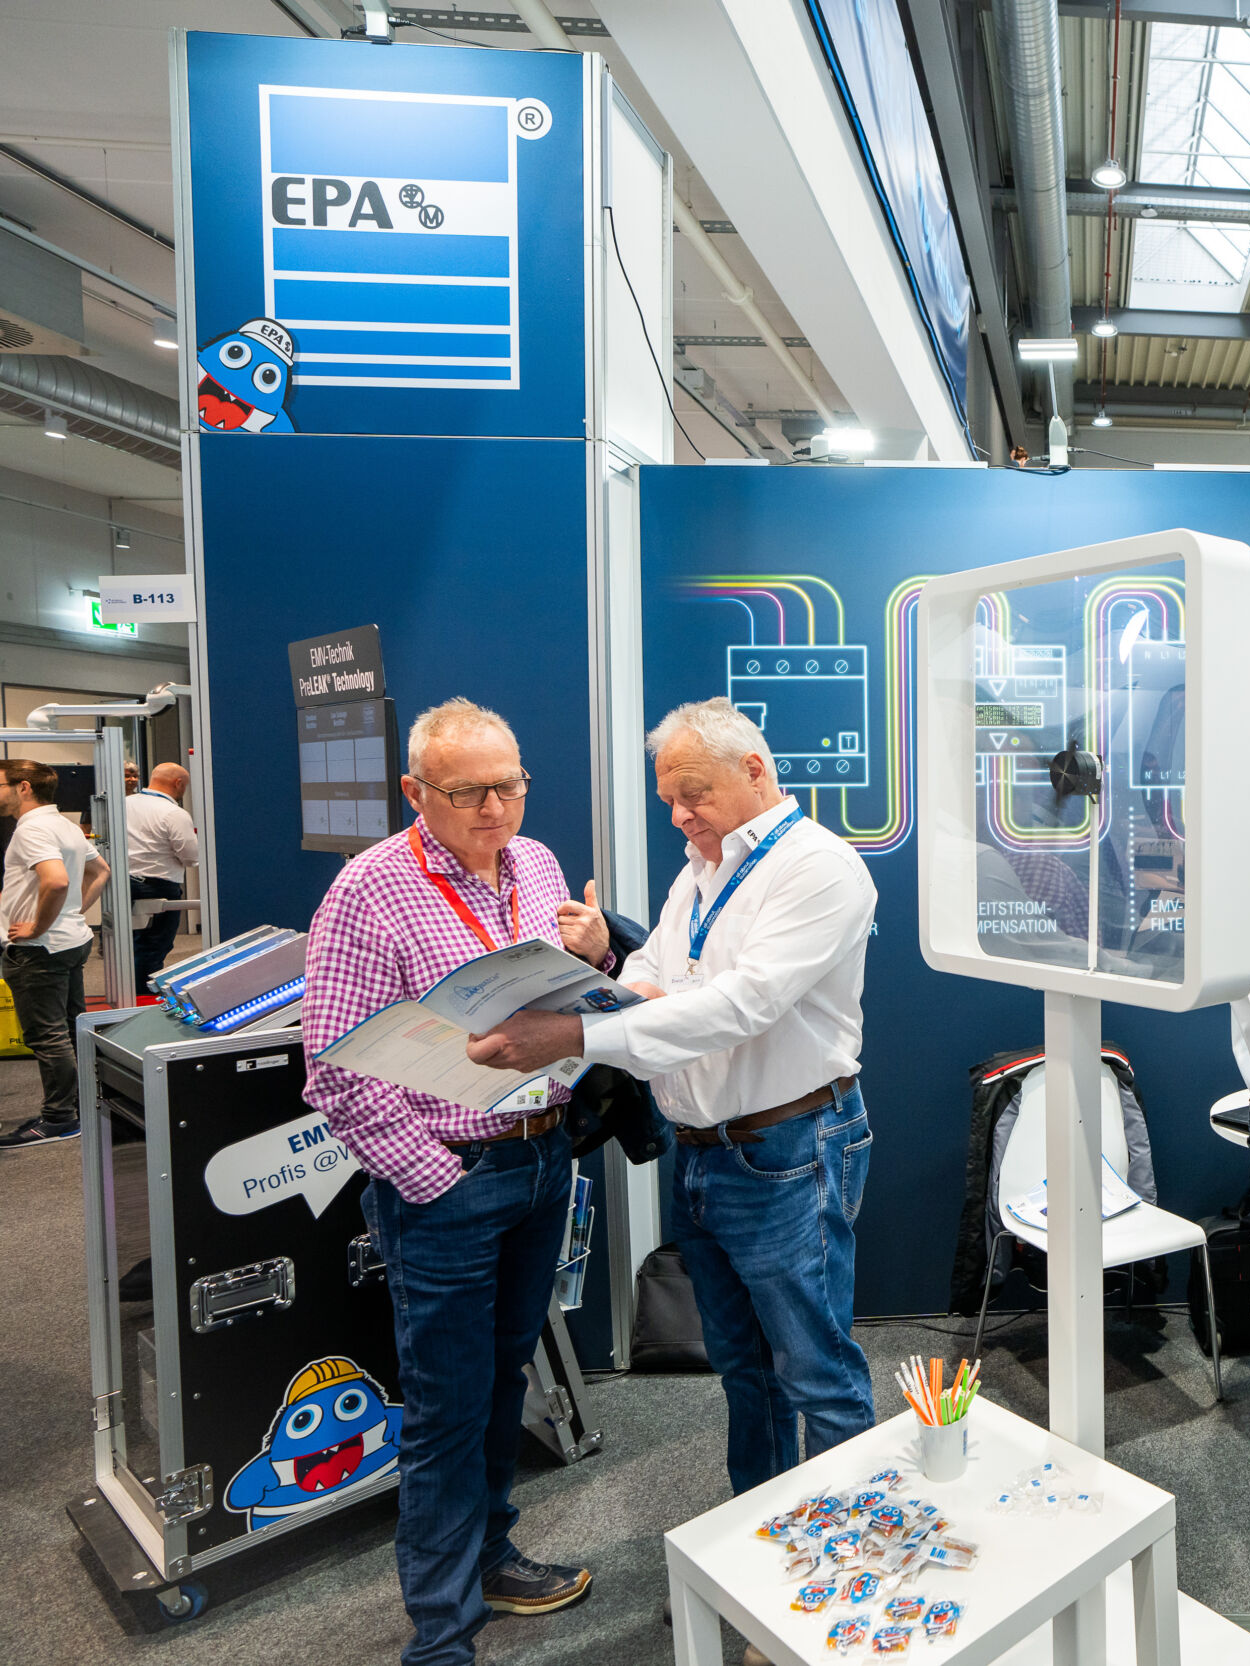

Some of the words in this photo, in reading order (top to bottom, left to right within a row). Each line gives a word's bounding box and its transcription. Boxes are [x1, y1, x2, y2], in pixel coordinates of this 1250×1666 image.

[271, 176, 393, 229] EPA
[261, 325, 283, 345] EPA
[133, 593, 175, 605] B-113
[310, 641, 354, 667] EMV-Technik
[332, 669, 375, 692] Technology
[747, 829, 758, 842] EPA
[977, 901, 1052, 916] EITSTROM-
[1151, 899, 1183, 913] EMV-
[1151, 917, 1184, 931] FILTE
[243, 1164, 306, 1199] Profis
